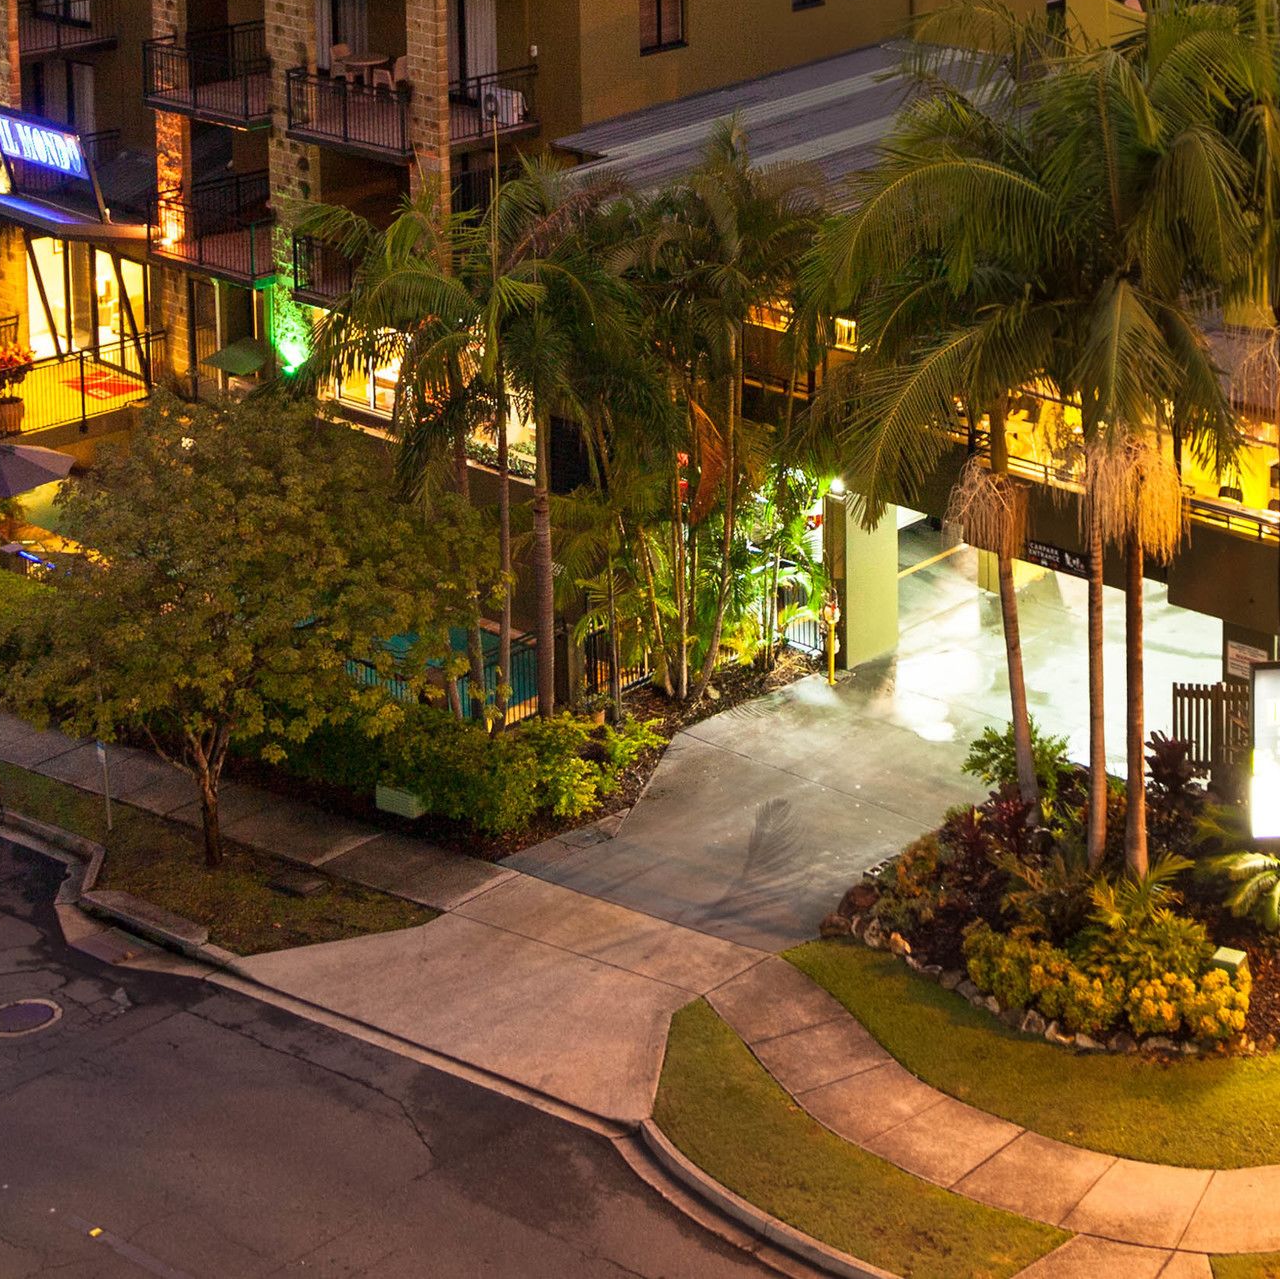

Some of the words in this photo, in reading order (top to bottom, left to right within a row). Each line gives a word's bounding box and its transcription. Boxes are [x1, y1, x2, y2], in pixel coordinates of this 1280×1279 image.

[14, 122, 82, 173] MONDO
[1028, 548, 1060, 563] ENTRANCE
[1029, 542, 1058, 555] CARPARK
